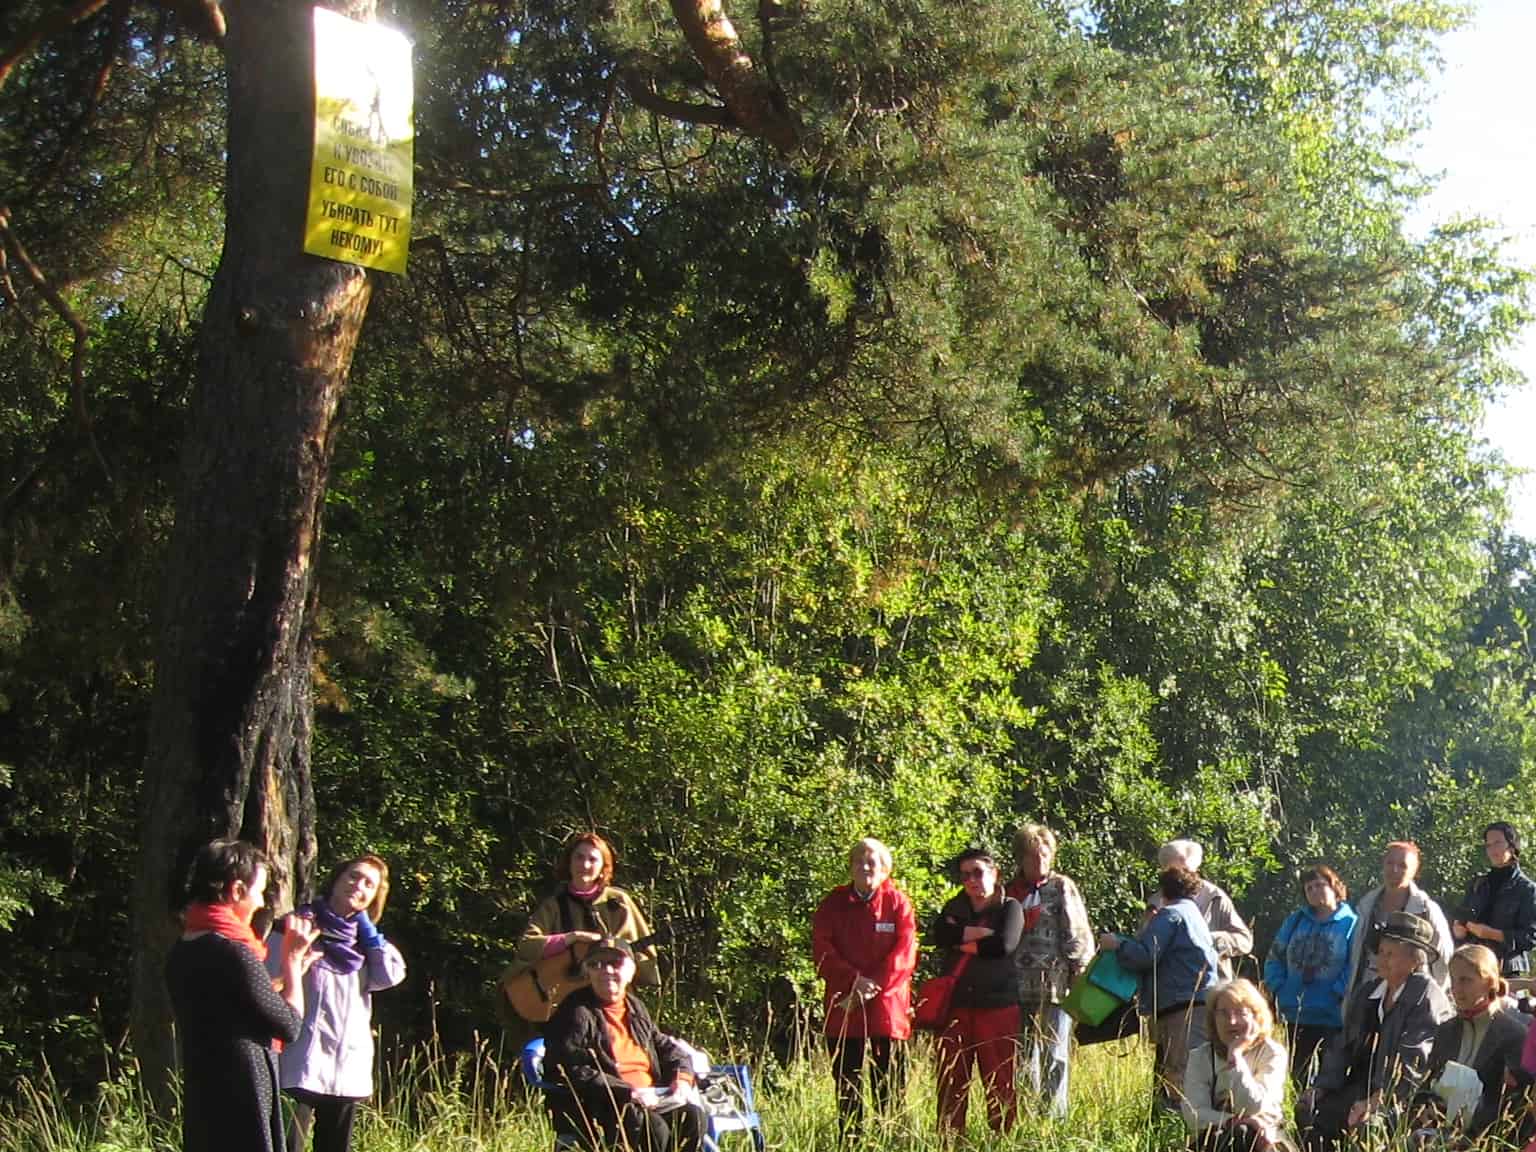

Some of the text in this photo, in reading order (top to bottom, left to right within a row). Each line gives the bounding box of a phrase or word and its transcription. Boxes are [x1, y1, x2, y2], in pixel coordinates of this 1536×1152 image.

[324, 166, 345, 187] ЕГО
[349, 174, 356, 190] С
[322, 200, 399, 234] УБИРАТЬ ТУТ
[331, 229, 384, 256] НЕКОМУ!
